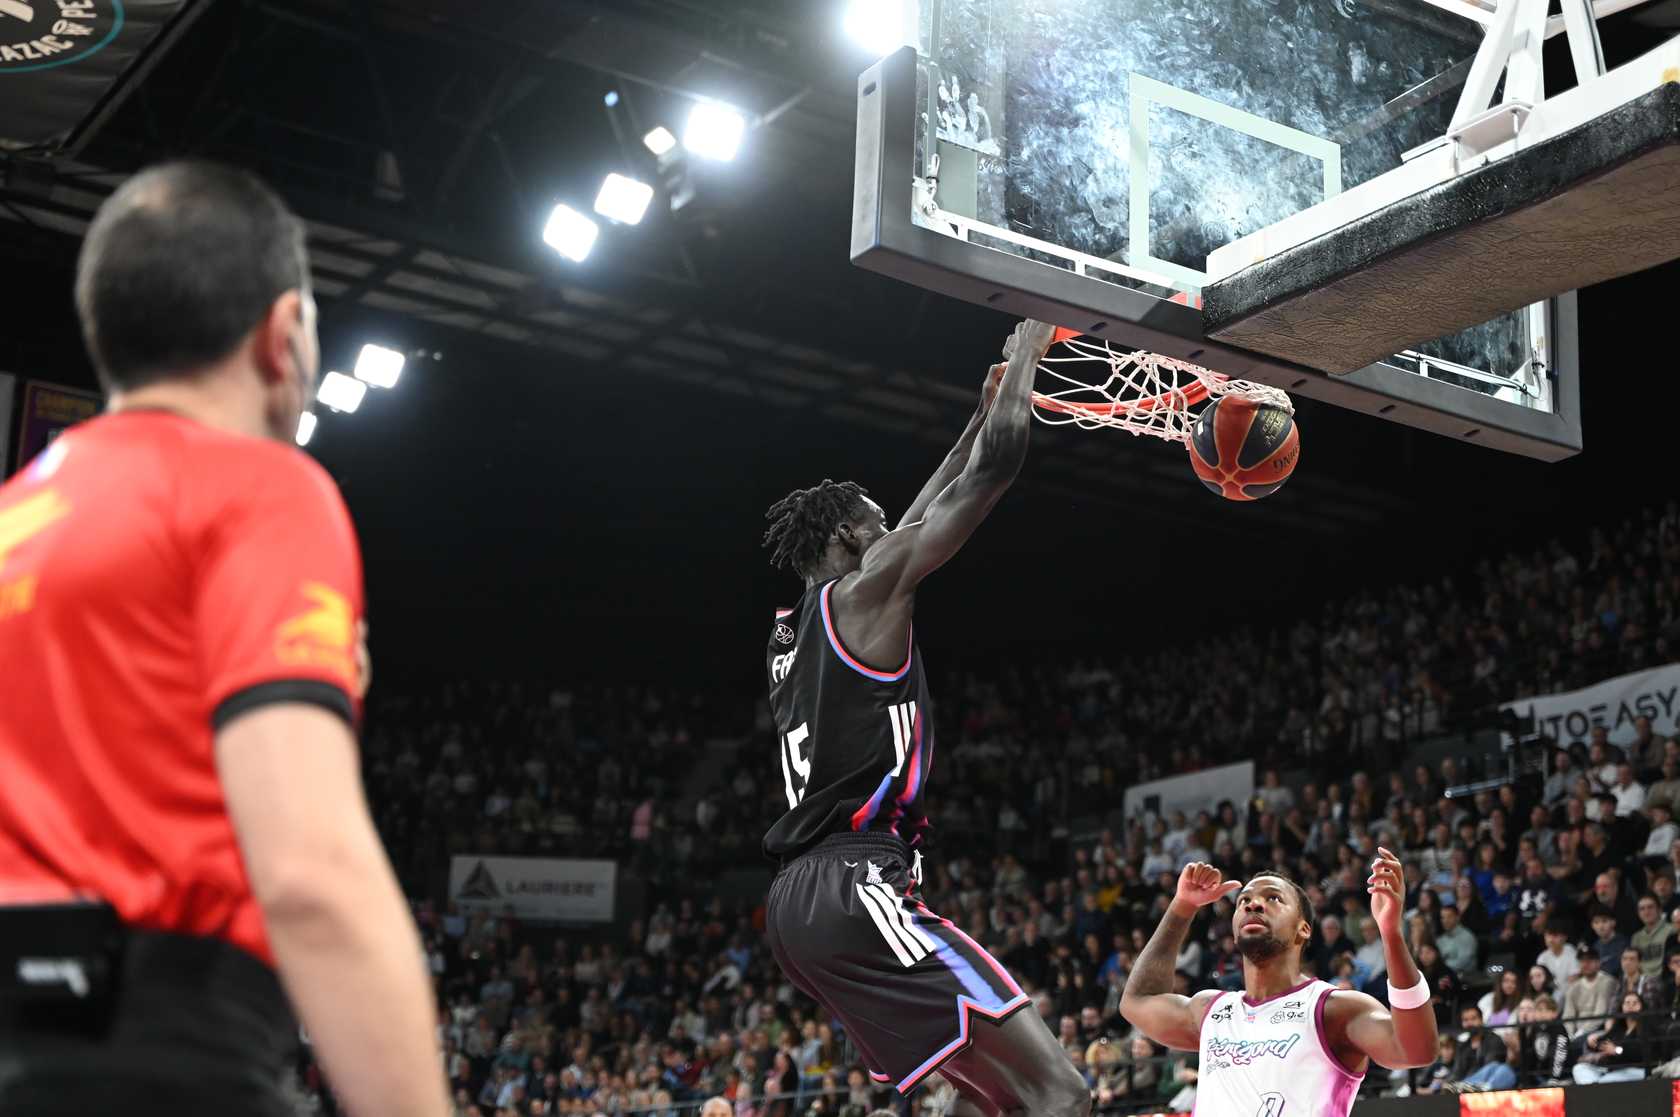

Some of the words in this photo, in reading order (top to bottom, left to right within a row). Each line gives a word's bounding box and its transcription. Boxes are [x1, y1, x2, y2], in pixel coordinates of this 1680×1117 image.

[0, 34, 74, 61] AZAC
[772, 646, 798, 683] FA
[781, 722, 811, 810] 15
